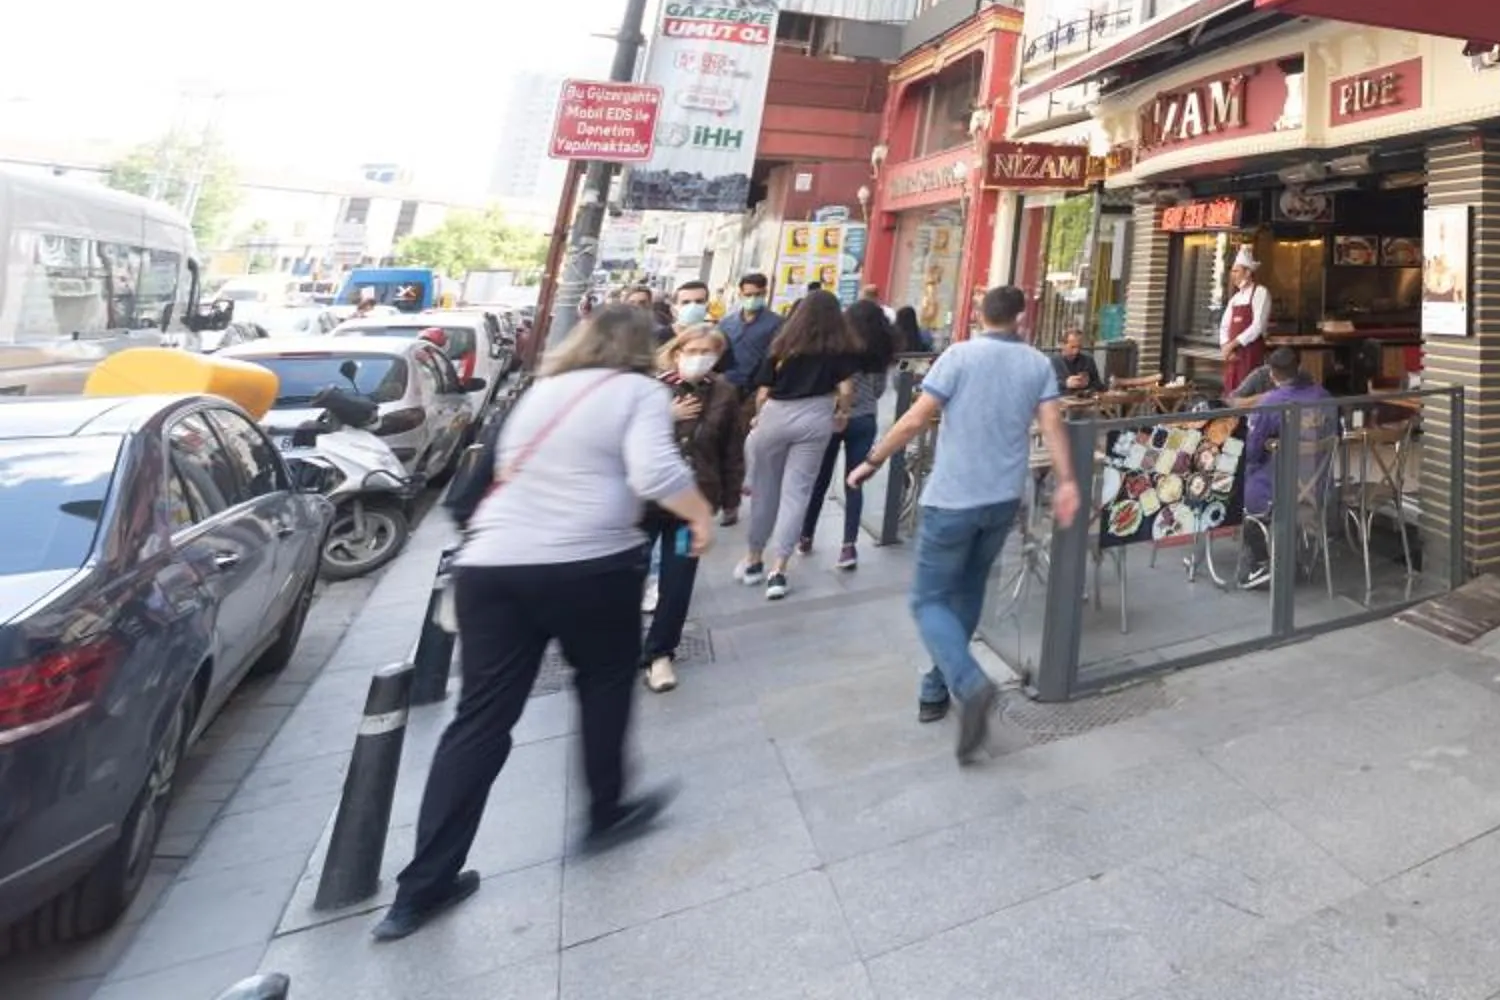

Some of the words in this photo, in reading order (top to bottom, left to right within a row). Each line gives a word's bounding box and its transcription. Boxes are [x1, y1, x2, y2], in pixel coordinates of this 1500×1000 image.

[668, 21, 737, 38] UMUT
[739, 27, 767, 42] OL
[606, 107, 632, 120] EDS
[577, 122, 635, 137] Denetim
[993, 148, 1081, 179] NİZAM
